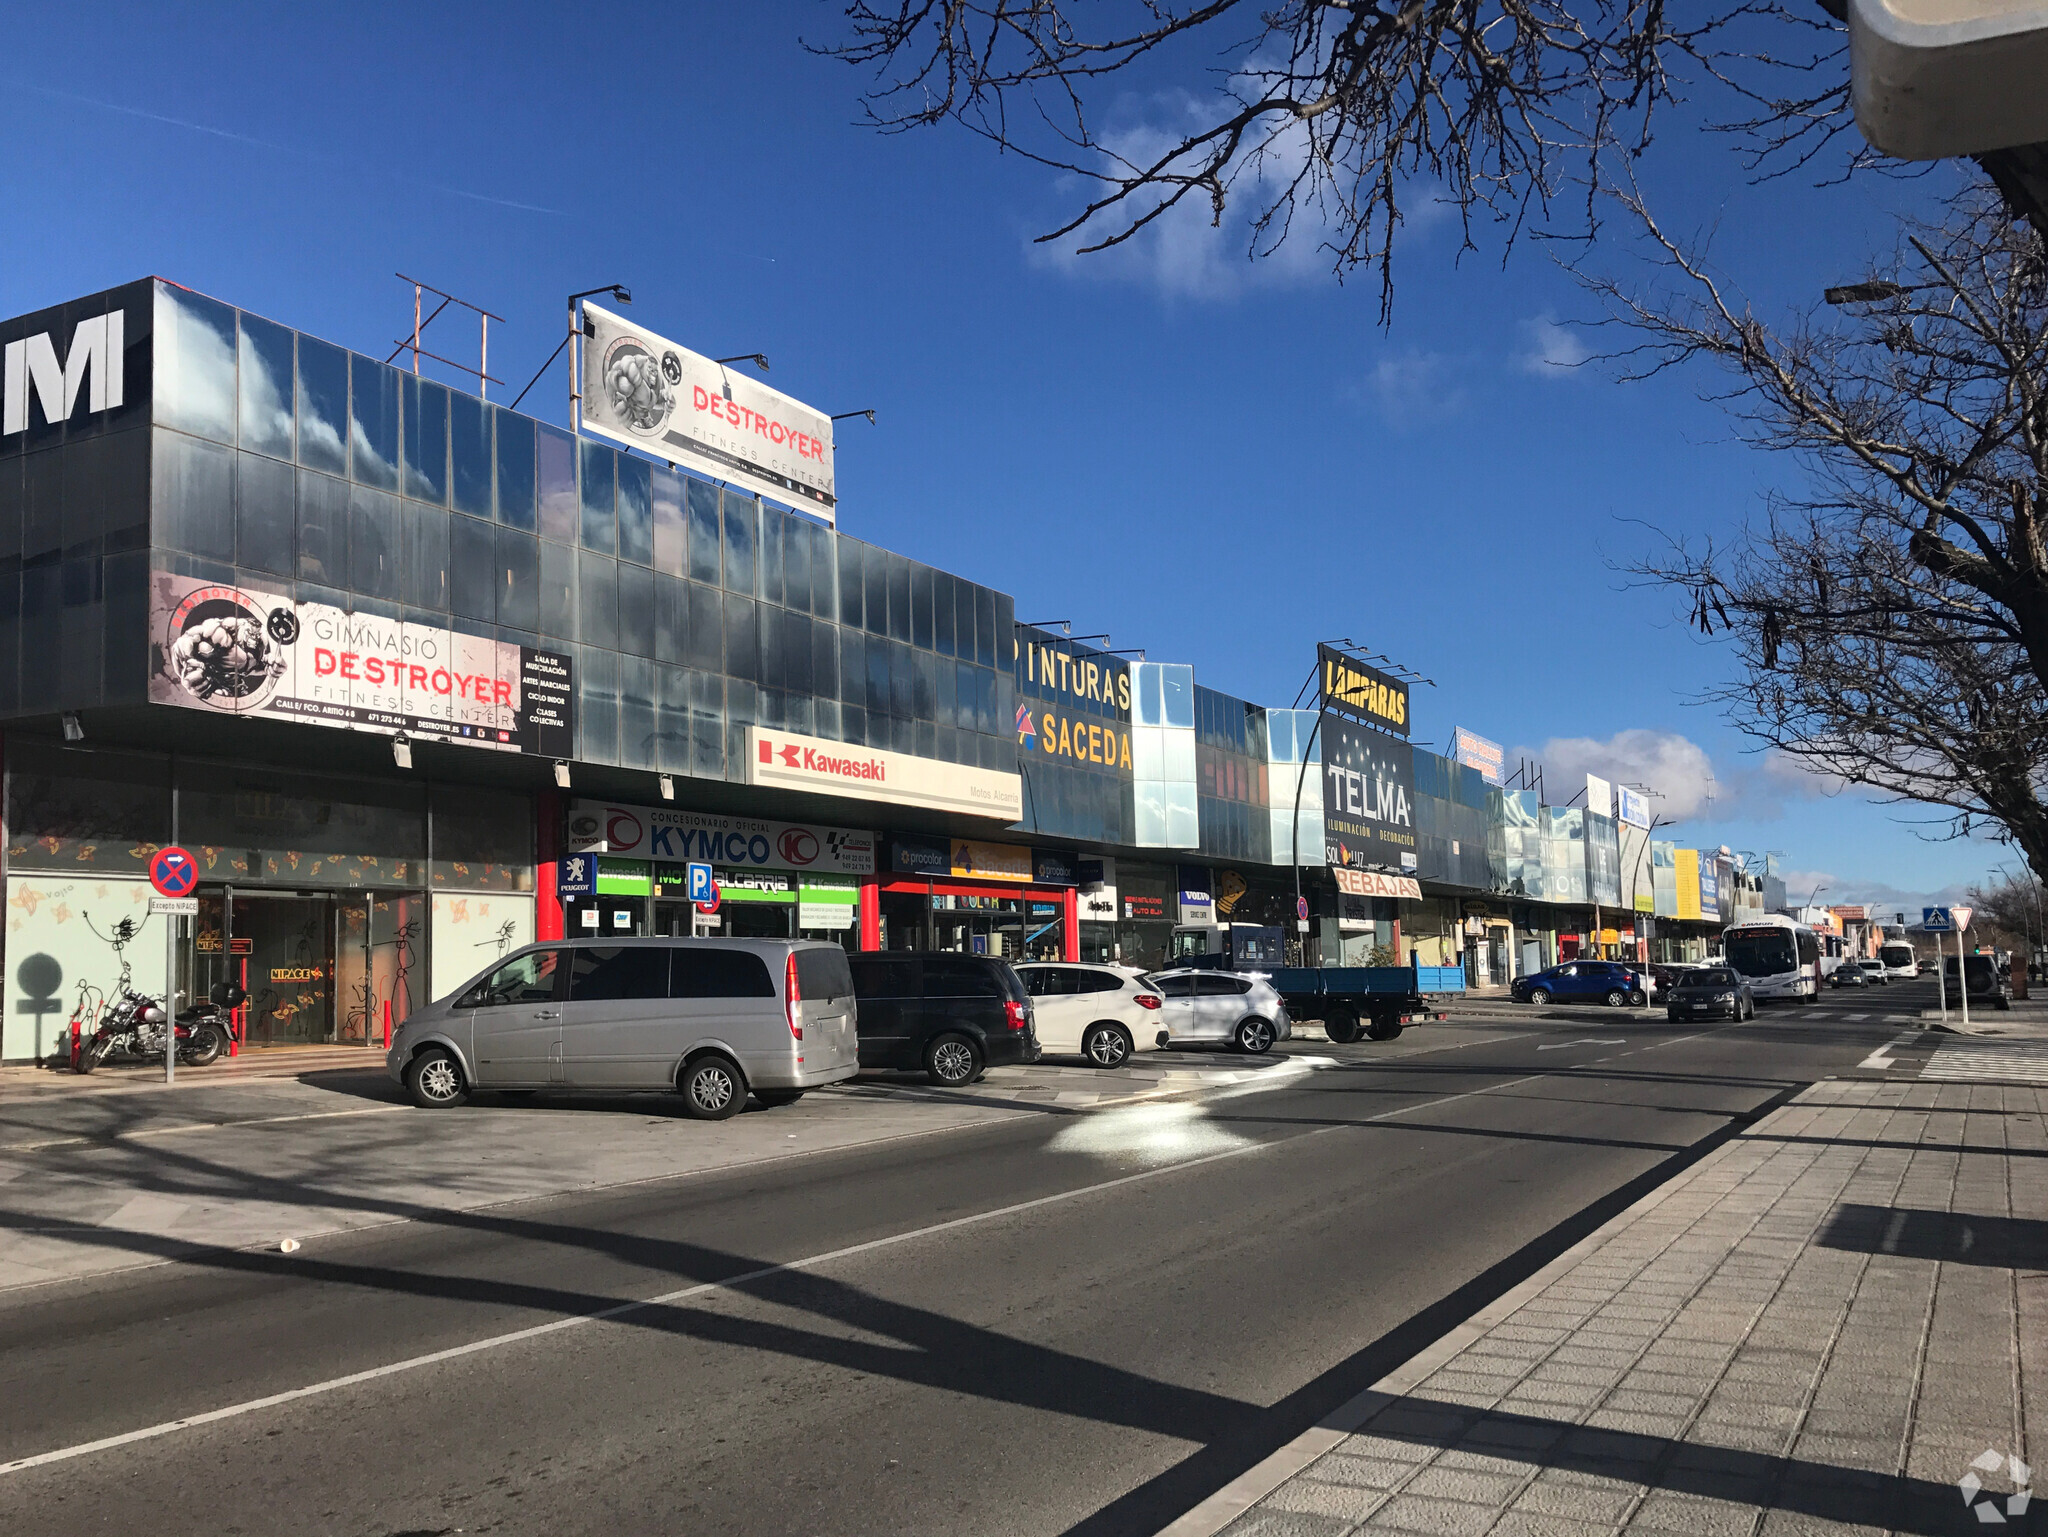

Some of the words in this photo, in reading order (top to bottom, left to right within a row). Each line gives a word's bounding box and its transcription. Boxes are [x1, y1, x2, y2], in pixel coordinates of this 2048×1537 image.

[693, 385, 825, 464] DESTROYER
[693, 426, 758, 461] FITNESS
[771, 459, 825, 487] CENTER
[172, 587, 252, 628] DESTROYER
[314, 619, 437, 660] GIMNASIO
[525, 662, 567, 676] MUSCULACIÓN
[534, 655, 550, 665] SALA
[550, 658, 558, 666] DE
[314, 647, 514, 708] DESTROYER
[522, 677, 539, 686] ARTES
[539, 680, 571, 691] MARCIALES
[528, 692, 547, 703] CICLO
[1326, 657, 1405, 725] LÁMPARAS
[275, 699, 302, 711] CALLE/
[303, 703, 321, 713] FCO.
[368, 713, 380, 722] 671
[380, 715, 393, 723] 273
[393, 717, 407, 726] 446
[417, 720, 460, 734] DESTROYER.ES
[314, 685, 414, 712] FITNESS
[430, 704, 510, 727] CENTER
[536, 708, 557, 718] CLASES
[529, 715, 564, 727] COLECTIVAS
[1042, 713, 1132, 770] SACEDA
[803, 747, 885, 781] Kawasaki
[970, 786, 991, 800] Motos
[994, 788, 1019, 803] Alcarria
[1328, 762, 1411, 828] TELMA
[651, 812, 729, 829] CONCESIONARIO
[736, 821, 770, 832] OFICIAL
[1328, 818, 1371, 838] ILUMINACIÓN
[1379, 829, 1415, 847] DECORACIÓN
[571, 837, 599, 845] KYMCO
[651, 825, 770, 864] KYMCO
[910, 851, 942, 866] procolor
[975, 854, 1031, 878] Saceda
[1326, 845, 1340, 865] SOL
[1047, 864, 1071, 878] procolor
[560, 884, 590, 892] PEUGEOT
[693, 868, 707, 897] P
[1335, 870, 1420, 897] REBAJAS
[152, 901, 175, 911] Excepto
[176, 901, 197, 911] NIPACE
[1184, 890, 1210, 901] VOLVO
[270, 968, 311, 980] NIPACE
